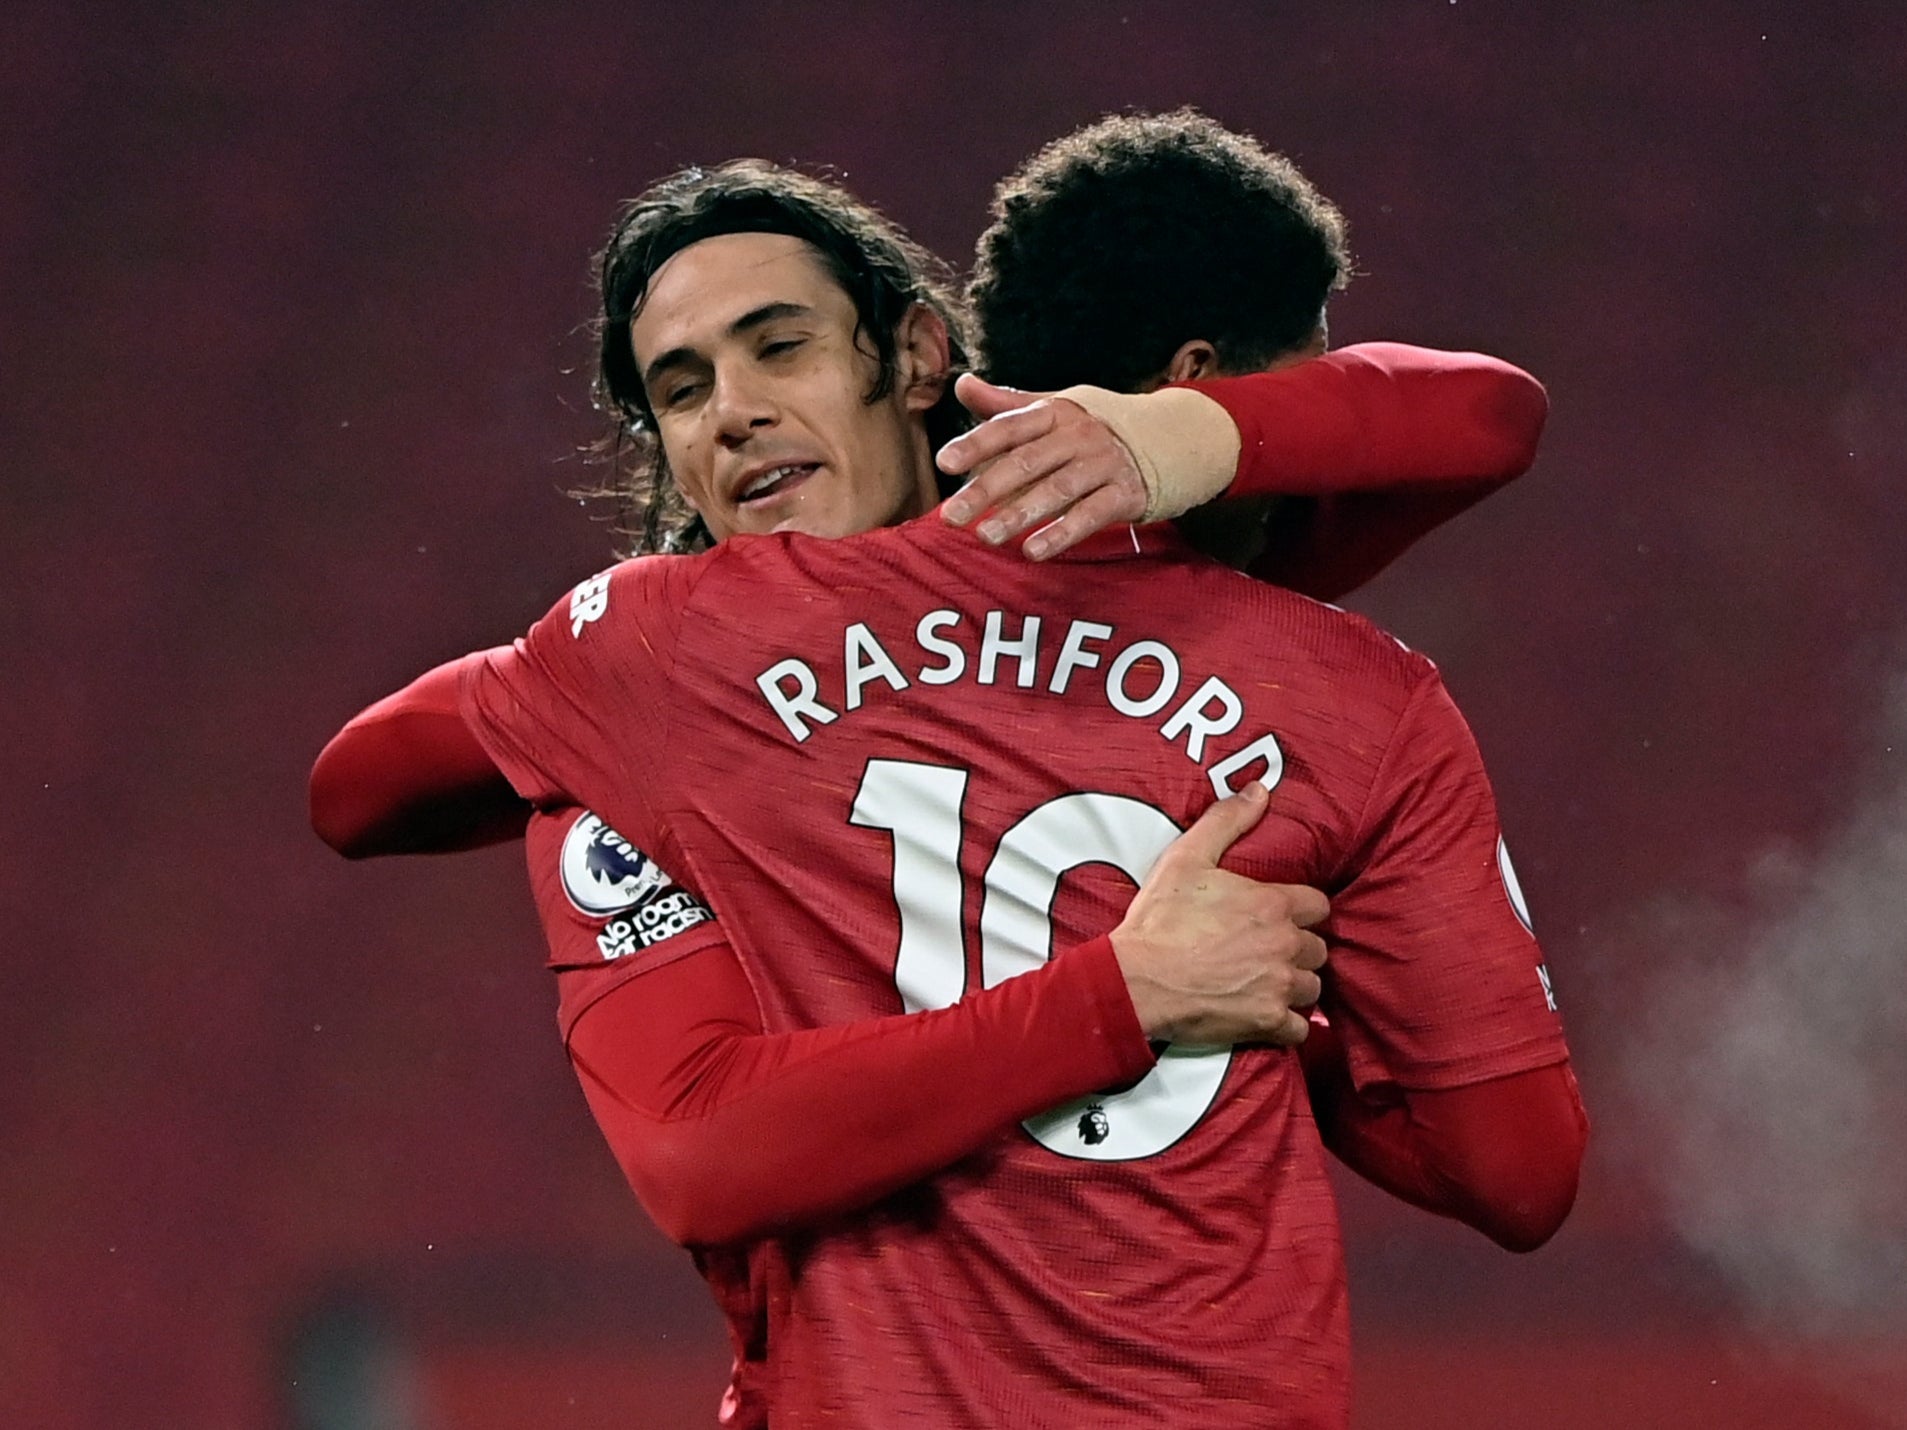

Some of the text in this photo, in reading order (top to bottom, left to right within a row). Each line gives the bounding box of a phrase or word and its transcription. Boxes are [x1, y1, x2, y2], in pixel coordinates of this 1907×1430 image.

[755, 609, 1284, 801] RASHFORD
[596, 892, 699, 953] No room
[849, 757, 1233, 1162] 10
